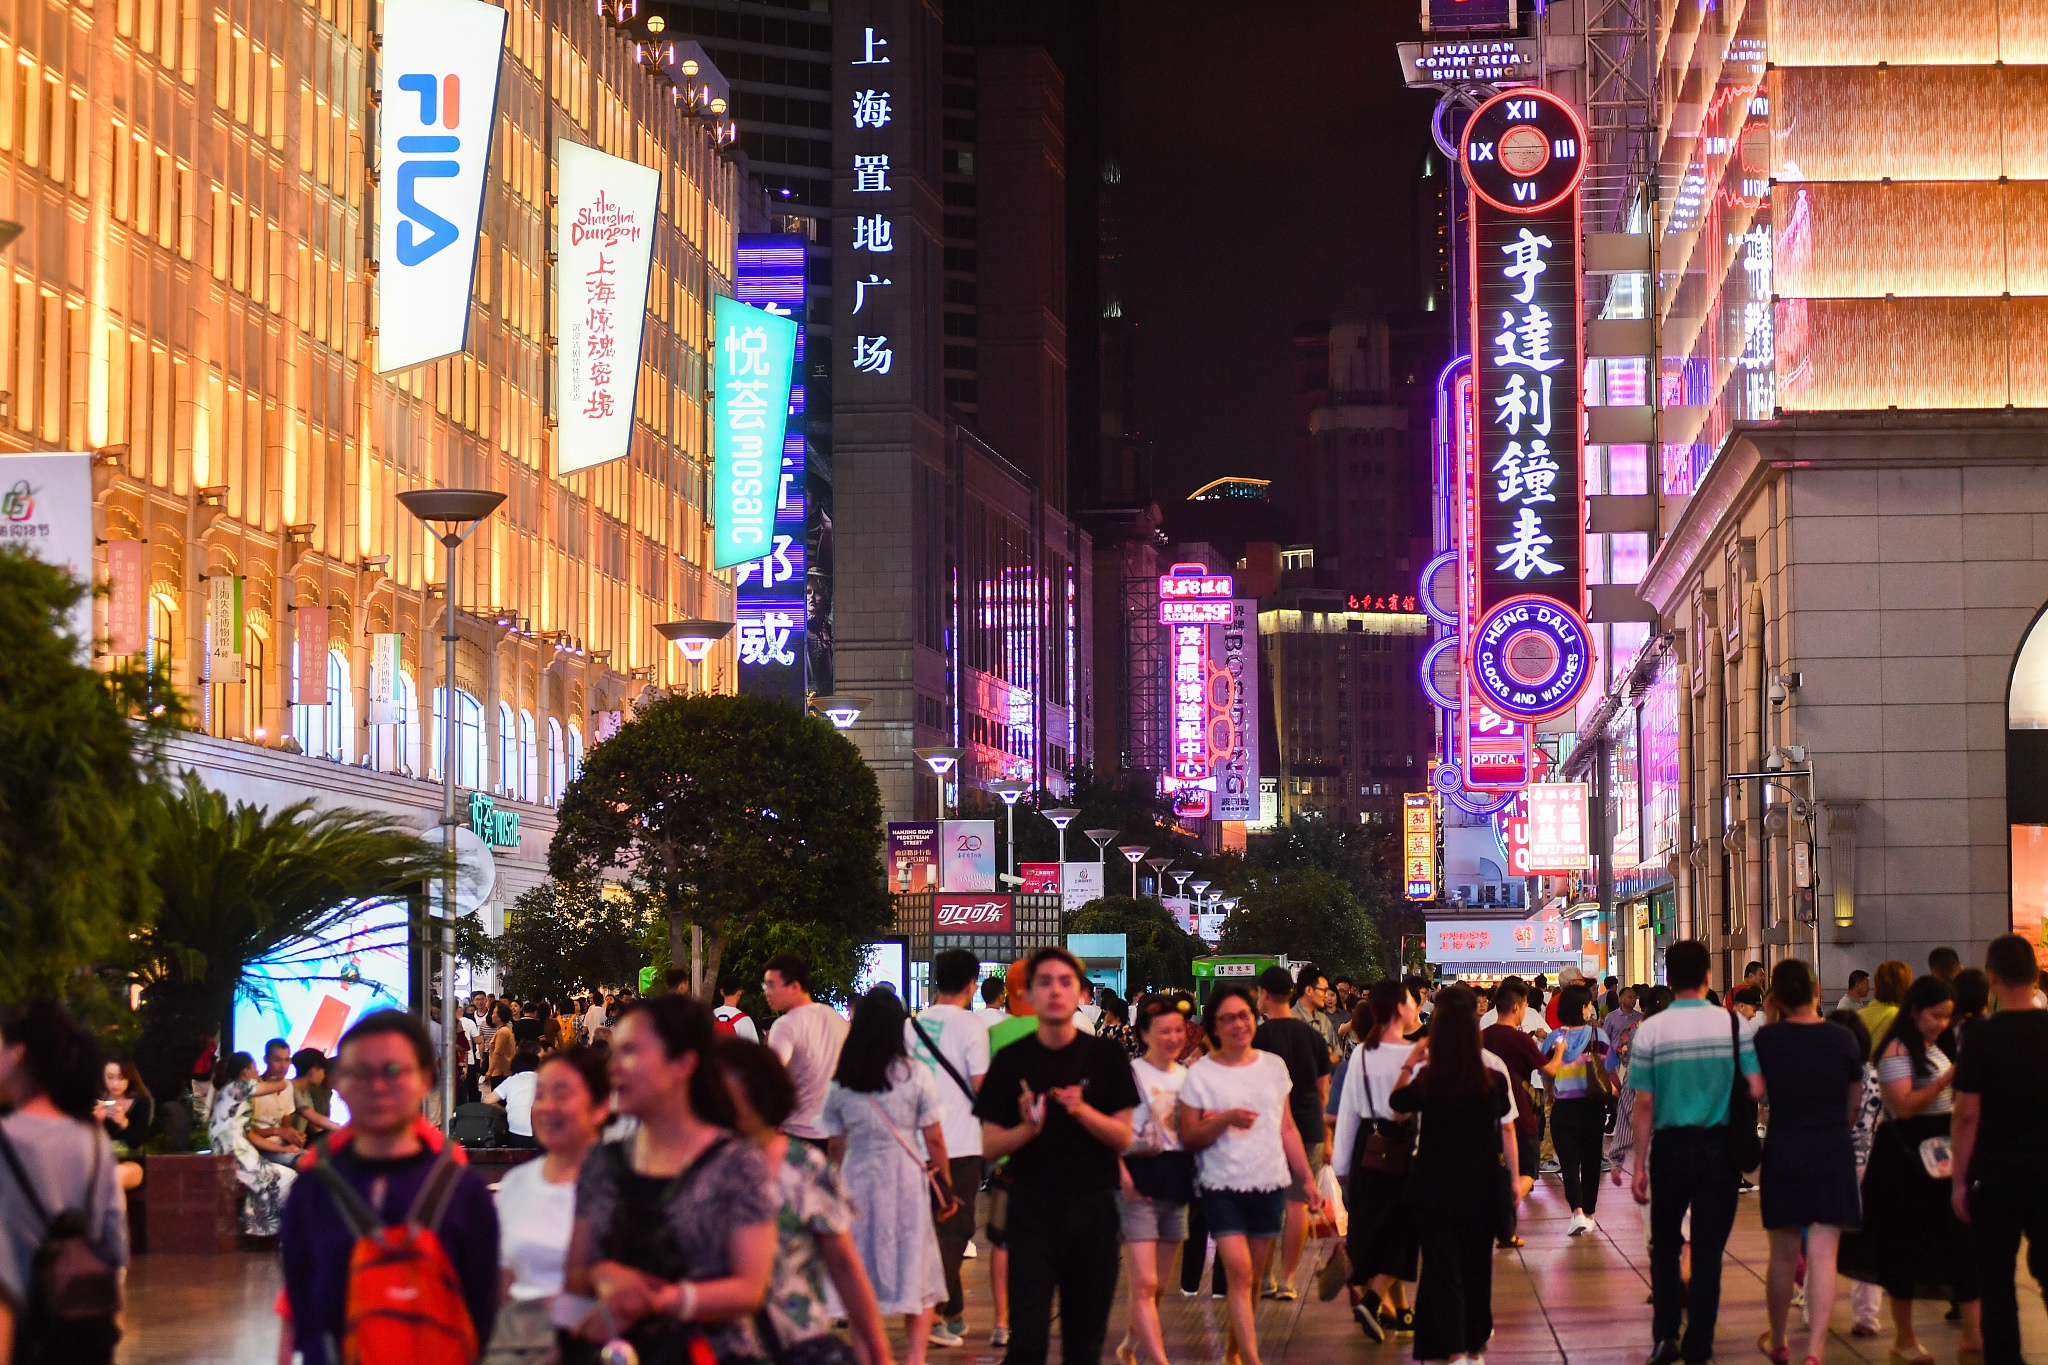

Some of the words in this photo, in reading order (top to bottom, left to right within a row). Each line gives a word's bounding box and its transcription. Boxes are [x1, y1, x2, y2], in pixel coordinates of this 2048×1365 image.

[1432, 42, 1514, 55] HUALIAN
[1415, 54, 1532, 68] COMMERCIAL
[1432, 67, 1515, 80] BUILDING
[1506, 101, 1537, 119] XII
[1470, 142, 1494, 160] IX
[1555, 139, 1575, 157] III
[397, 74, 460, 266] FILA
[593, 190, 616, 212] the
[851, 27, 893, 376] 上海置地广场
[1512, 182, 1536, 200] VI
[578, 207, 635, 227] Shanghai
[571, 222, 641, 248] Dungeon
[725, 325, 770, 430] 悦荟
[1491, 227, 1565, 580] 亨達利鐘表
[731, 435, 763, 544] mosaic
[1484, 607, 1530, 645] HENG
[1536, 607, 1576, 643] DALI
[1482, 651, 1510, 697] CLOCKS
[1512, 691, 1537, 705] AND
[1541, 652, 1579, 702] WATCHES
[957, 835, 982, 851] 20
[937, 901, 1008, 925] 可口可乐
